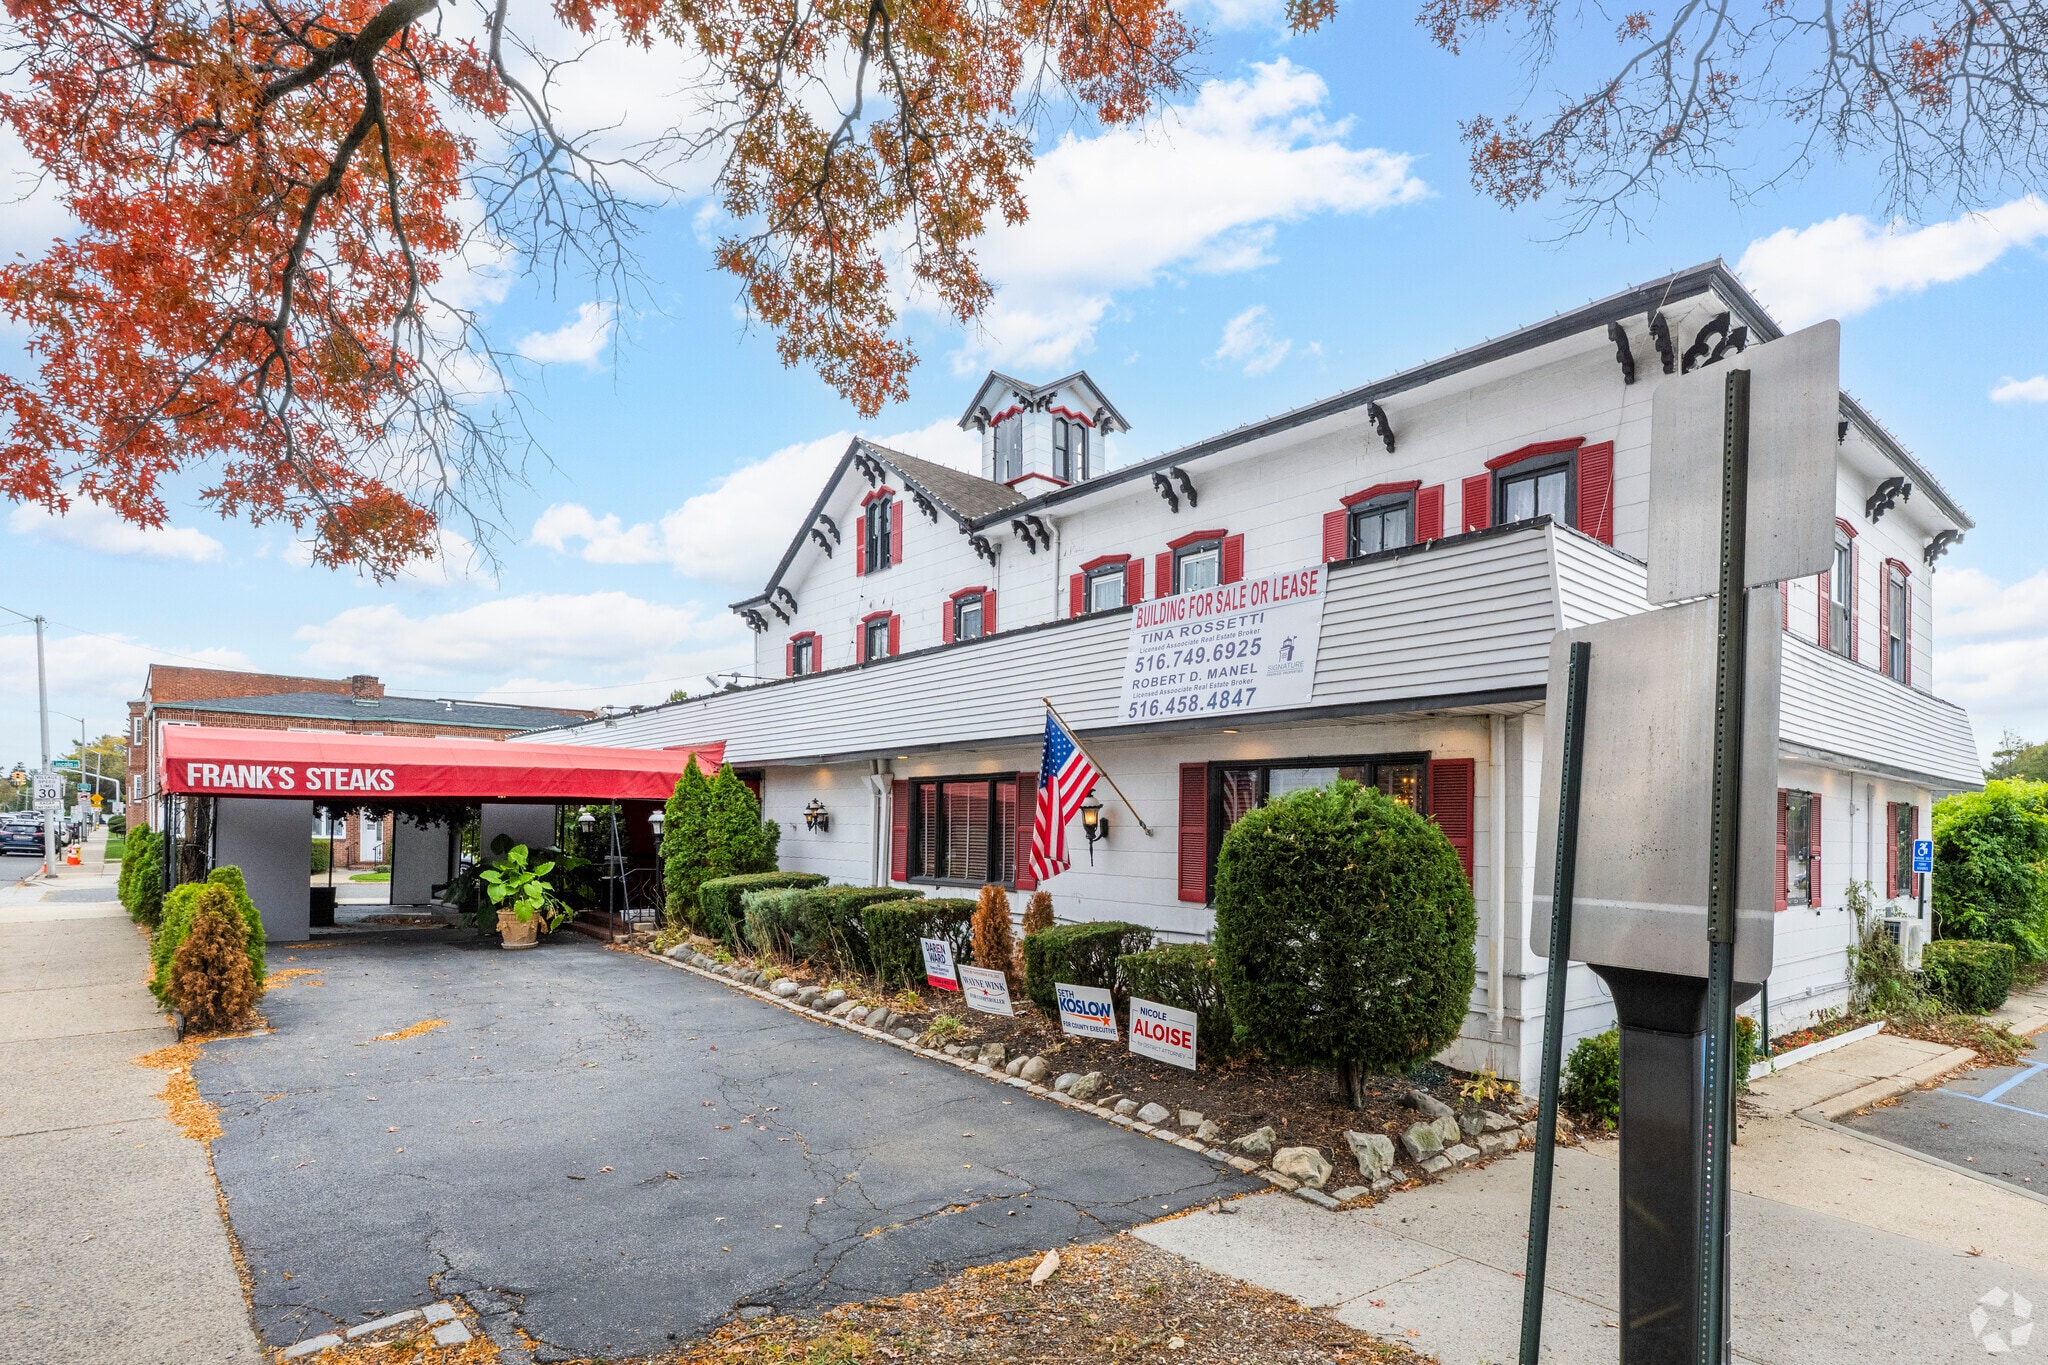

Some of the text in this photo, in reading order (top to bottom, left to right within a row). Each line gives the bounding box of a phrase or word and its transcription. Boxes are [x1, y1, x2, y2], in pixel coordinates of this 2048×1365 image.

[1136, 569, 1319, 629] BUILDING FOR SALE OR LEASE
[1141, 612, 1265, 645] TINA ROSSETTI
[1139, 644, 1166, 654] Licensed
[1200, 636, 1215, 644] Real
[1215, 632, 1236, 641] Estate
[1237, 628, 1261, 637] Broker
[1134, 637, 1262, 673] 516.749.6925
[1132, 662, 1258, 690] ROBERT D. MANEL
[1267, 660, 1305, 672] SIGNATURE
[1132, 689, 1158, 699] Licensed
[1193, 683, 1208, 691] Real
[1209, 680, 1229, 689] Estate
[1230, 678, 1254, 687] Broker
[1128, 687, 1257, 719] 516.458.4847
[187, 762, 395, 791] FRANK'S STEAKS
[38, 788, 56, 799] 30
[925, 941, 946, 955] DAREN
[928, 951, 946, 964] WARD
[962, 976, 986, 989] WAYNE
[985, 980, 1006, 992] WINK
[1057, 988, 1074, 999] SETH
[1059, 997, 1111, 1018] KOSLOW
[1140, 1006, 1167, 1021] NICOLE
[1062, 1020, 1117, 1035] FOR COUNTY EXECUTIVE
[1133, 1018, 1192, 1050] ALOISE
[1143, 1043, 1161, 1053] DISTRICT
[1161, 1047, 1187, 1060] ATTORNEY
